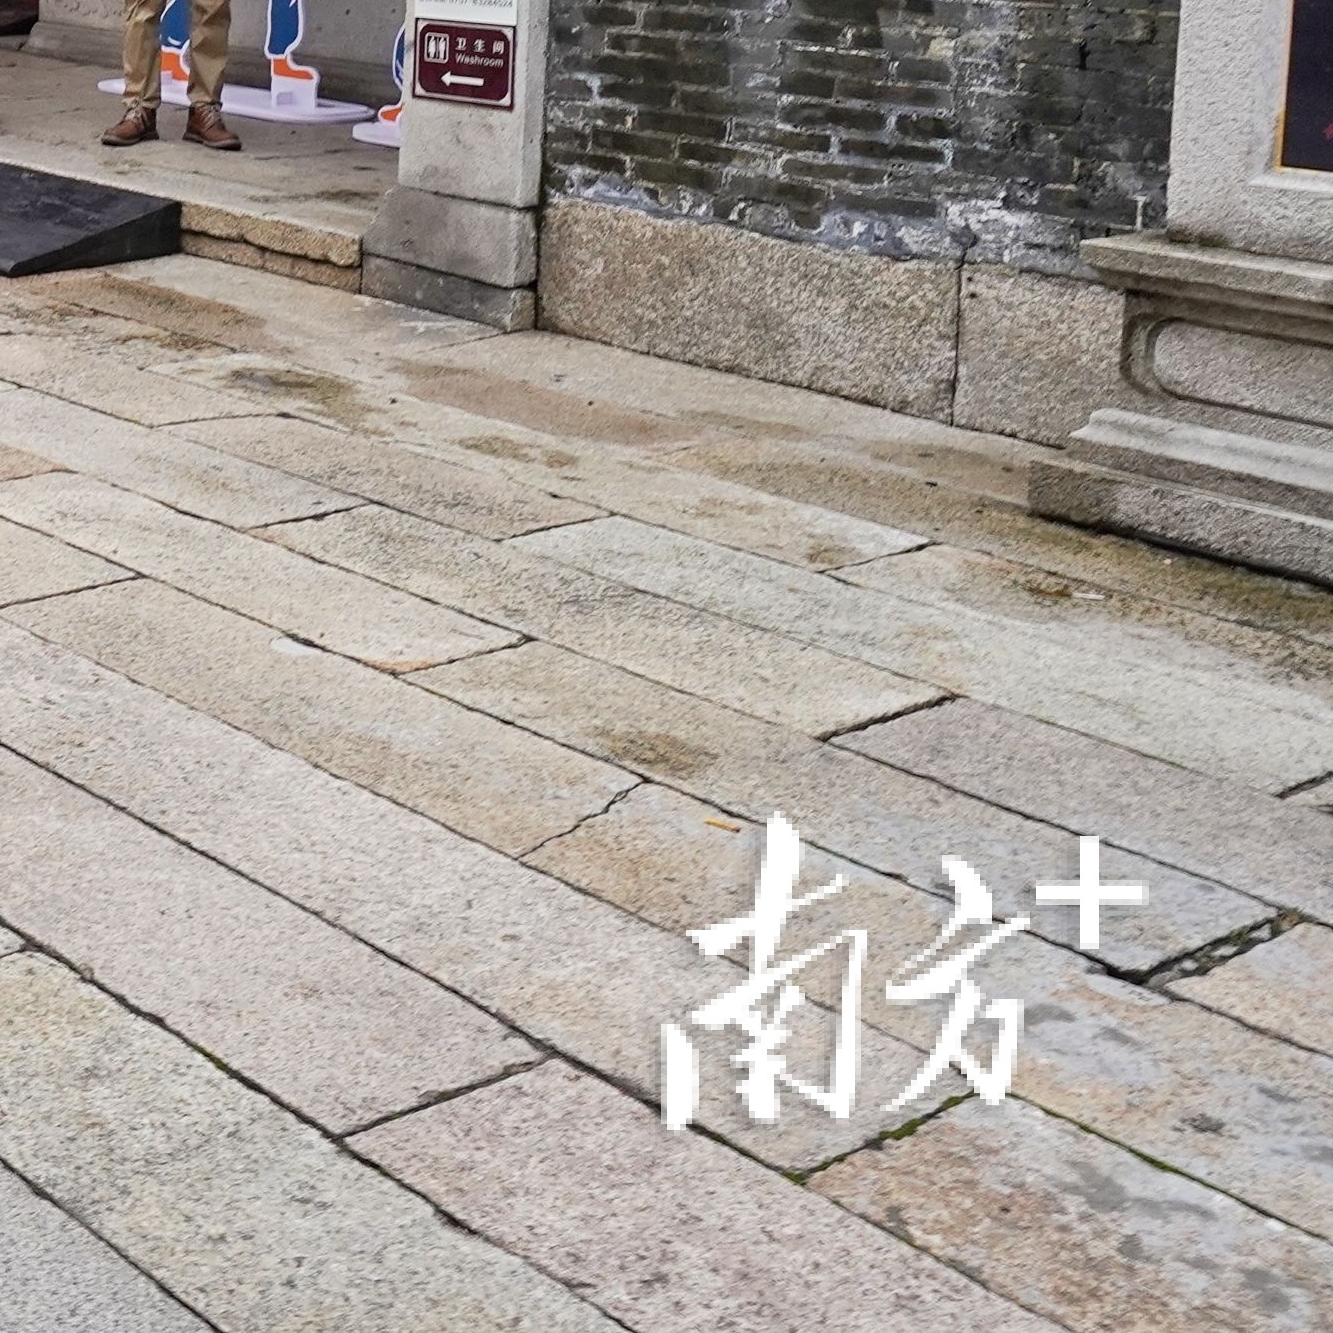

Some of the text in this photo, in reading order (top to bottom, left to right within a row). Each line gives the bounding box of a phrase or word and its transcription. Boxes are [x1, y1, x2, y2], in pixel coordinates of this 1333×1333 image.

[455, 37, 505, 55] 卫生间
[455, 53, 504, 68] Washroom
